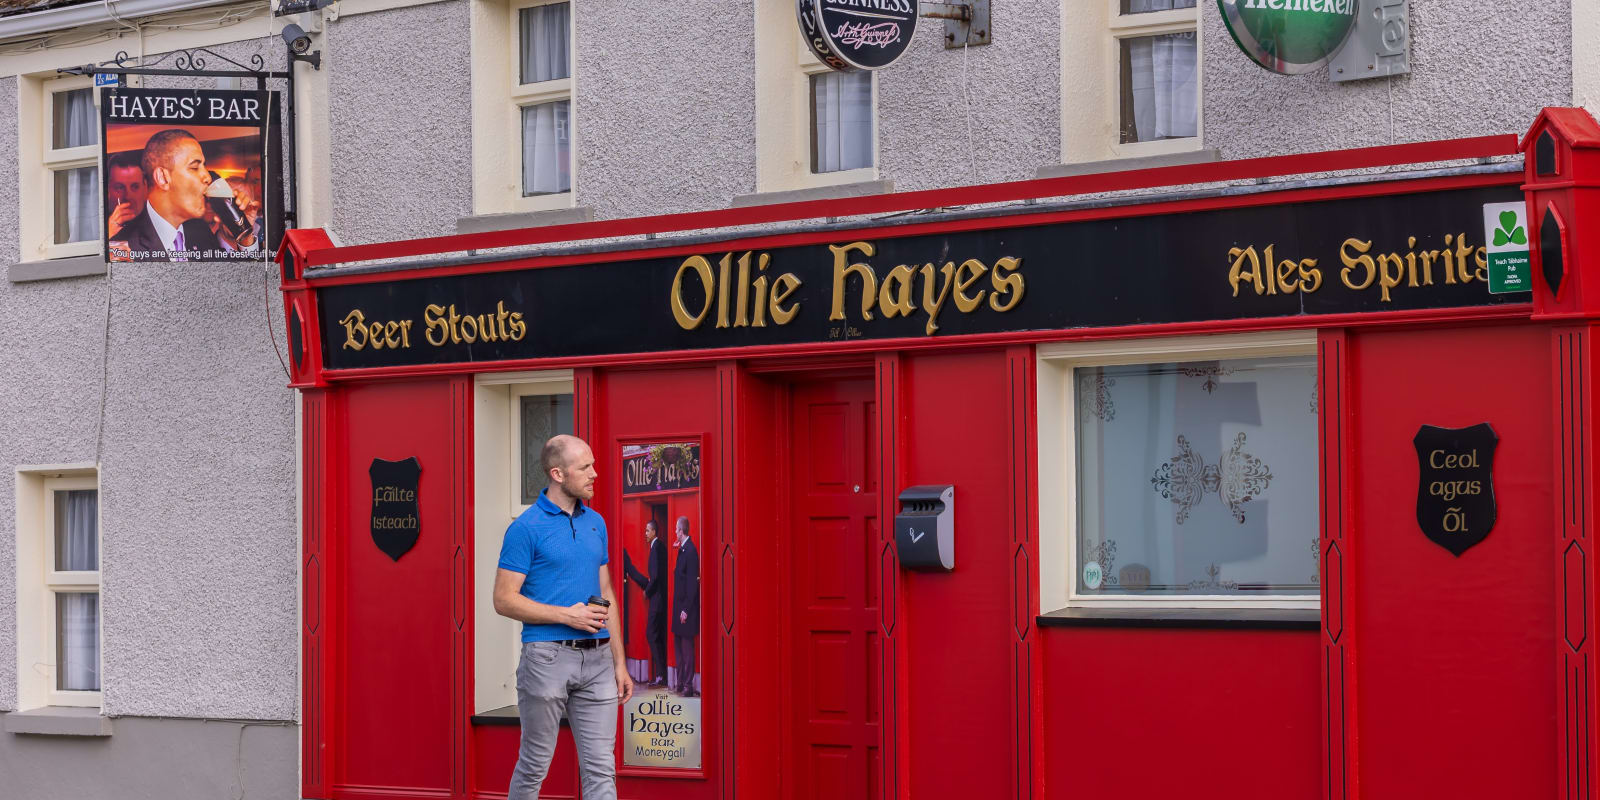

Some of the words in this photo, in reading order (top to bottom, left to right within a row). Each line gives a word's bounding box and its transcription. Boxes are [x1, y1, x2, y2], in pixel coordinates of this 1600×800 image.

[827, 0, 910, 13] NESS
[208, 97, 261, 120] BAR
[112, 249, 128, 258] You
[130, 250, 150, 260] guys
[152, 250, 165, 258] are
[168, 249, 201, 260] keeping
[203, 249, 213, 258] all
[215, 249, 228, 258] the
[230, 249, 248, 258] best
[250, 249, 267, 259] stuf
[1228, 243, 1324, 298] Ales
[670, 250, 802, 331] Ollie
[339, 308, 413, 351] Beer
[424, 300, 527, 347] Stouts
[1429, 448, 1480, 469] Ceol
[1429, 480, 1481, 502] agus
[638, 700, 682, 716] Ollie
[635, 745, 686, 760] Moneygall
